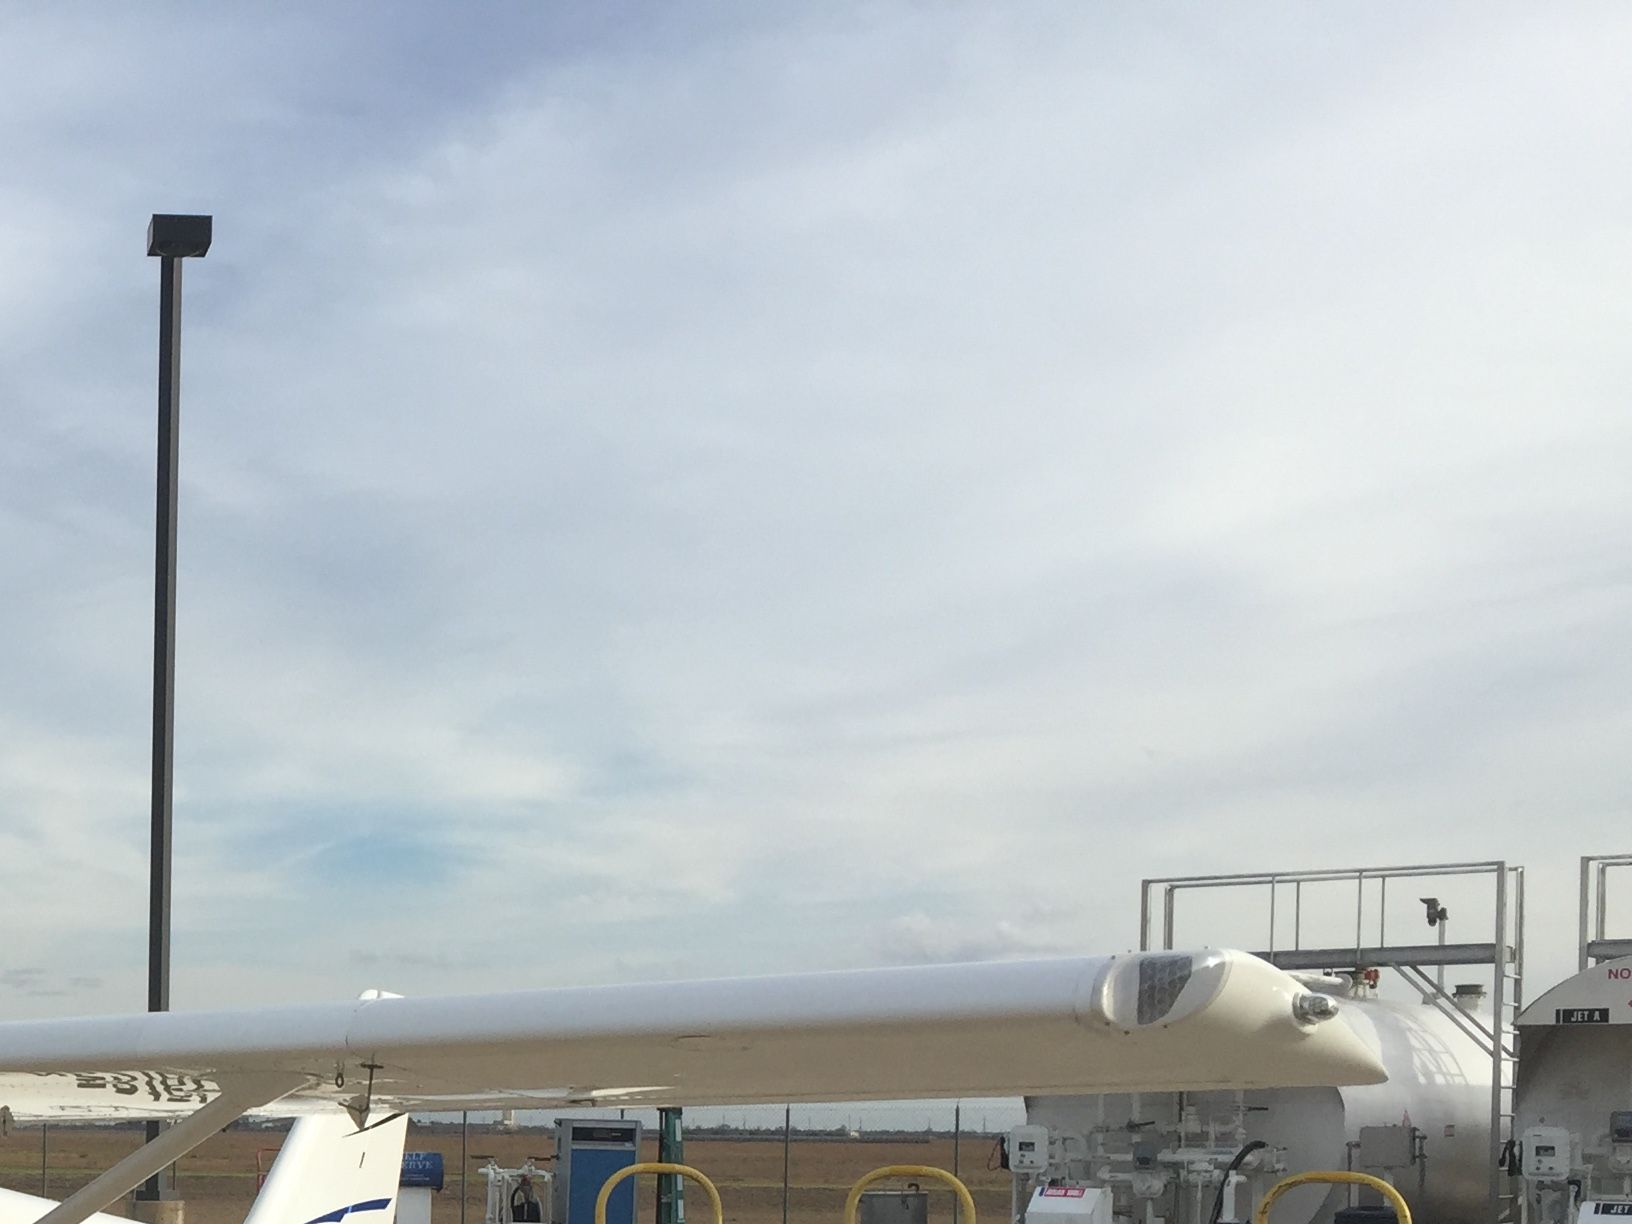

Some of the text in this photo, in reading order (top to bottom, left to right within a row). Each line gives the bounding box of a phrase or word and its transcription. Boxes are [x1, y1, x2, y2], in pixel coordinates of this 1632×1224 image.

[1608, 968, 1631, 980] NO
[1570, 1011, 1601, 1022] JET A
[1610, 1205, 1631, 1214] JET
